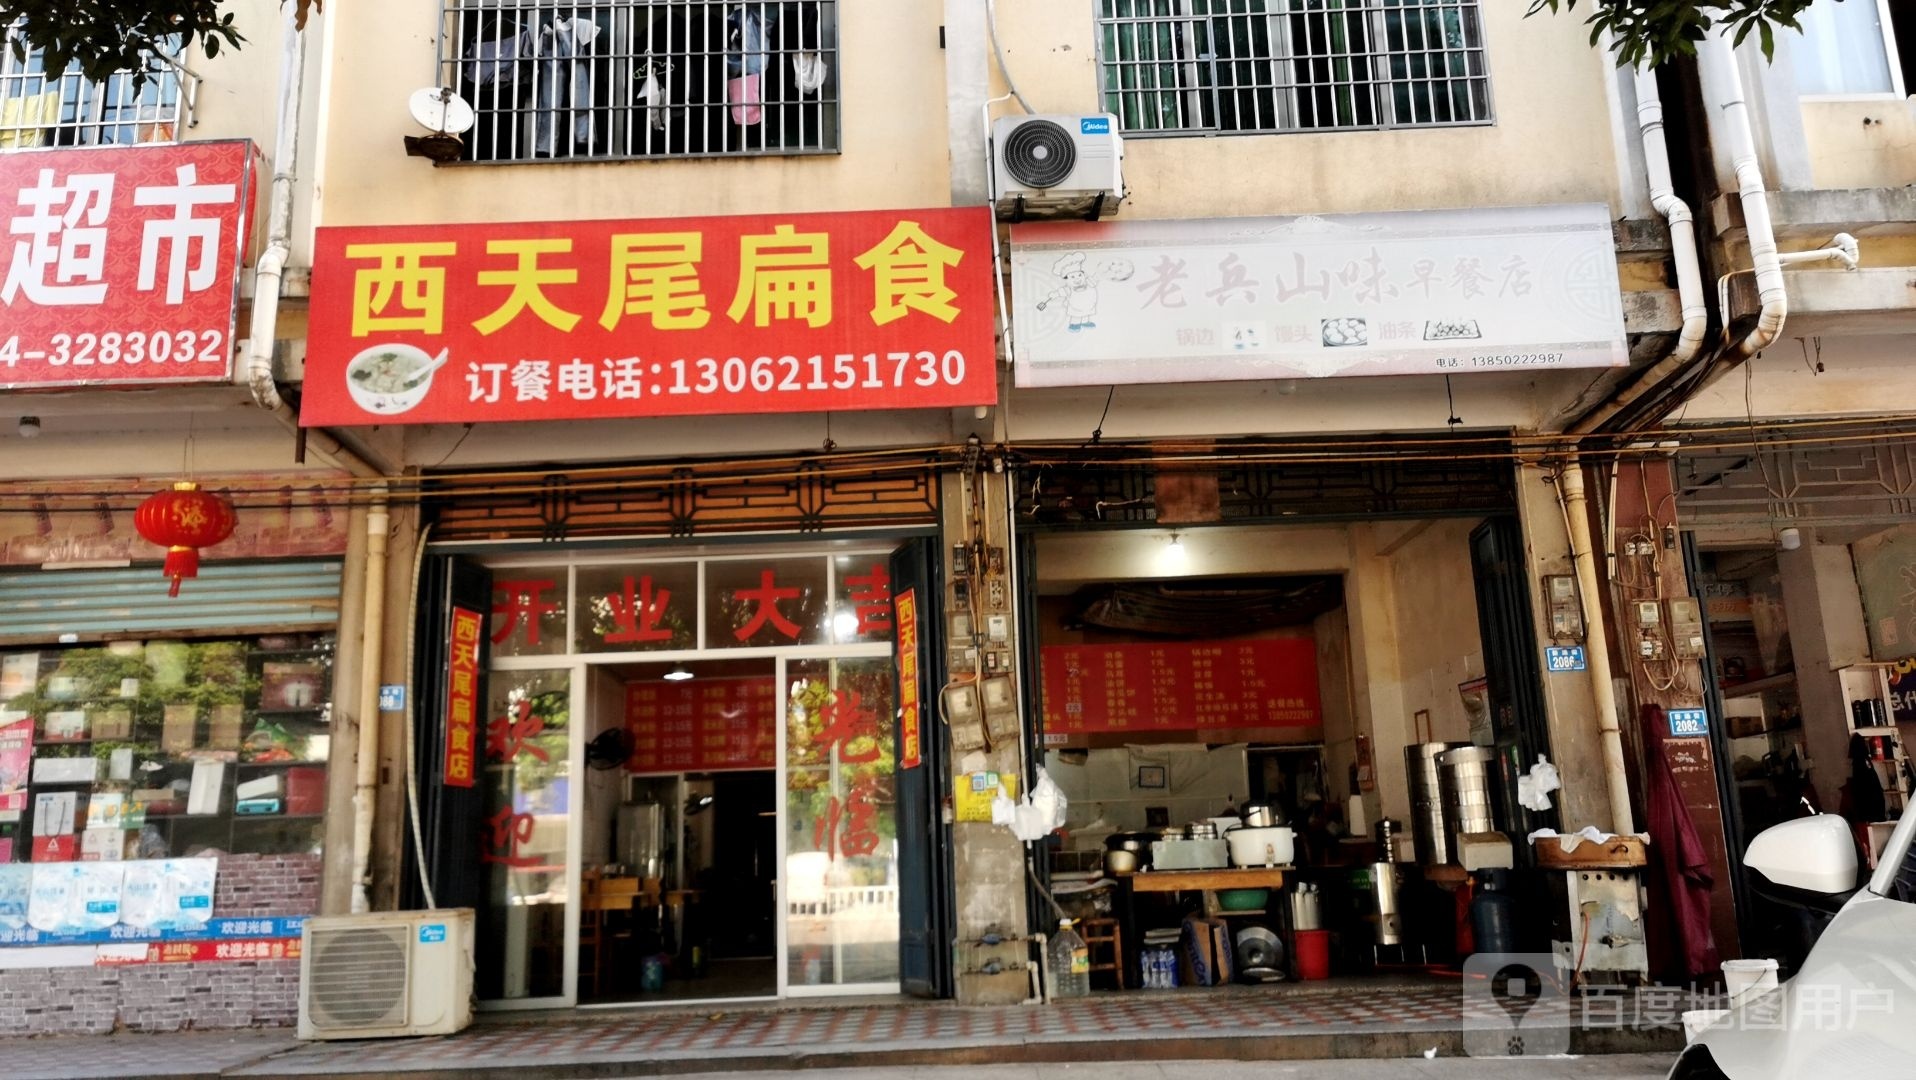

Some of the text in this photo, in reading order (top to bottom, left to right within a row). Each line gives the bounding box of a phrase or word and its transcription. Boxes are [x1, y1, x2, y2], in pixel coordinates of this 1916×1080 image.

[1083, 122, 1107, 131] Midea
[1, 163, 236, 306] 超市
[345, 220, 965, 337] 西天尾扁食
[1135, 247, 1534, 309] 老兵山味早餐店
[0, 330, 222, 367] 4-3283032
[1176, 321, 1416, 346] 锅边 馒头 油条
[465, 350, 965, 404] 订餐电话:13062151730
[492, 564, 891, 646] 开业大吉
[449, 615, 477, 779] 西天尾扁食店
[898, 597, 918, 760] 西天尾扁食店
[1676, 720, 1699, 732] 2082
[814, 689, 882, 861] 光临
[216, 942, 271, 958] 欢迎光临
[222, 921, 273, 934] 欢迎光临
